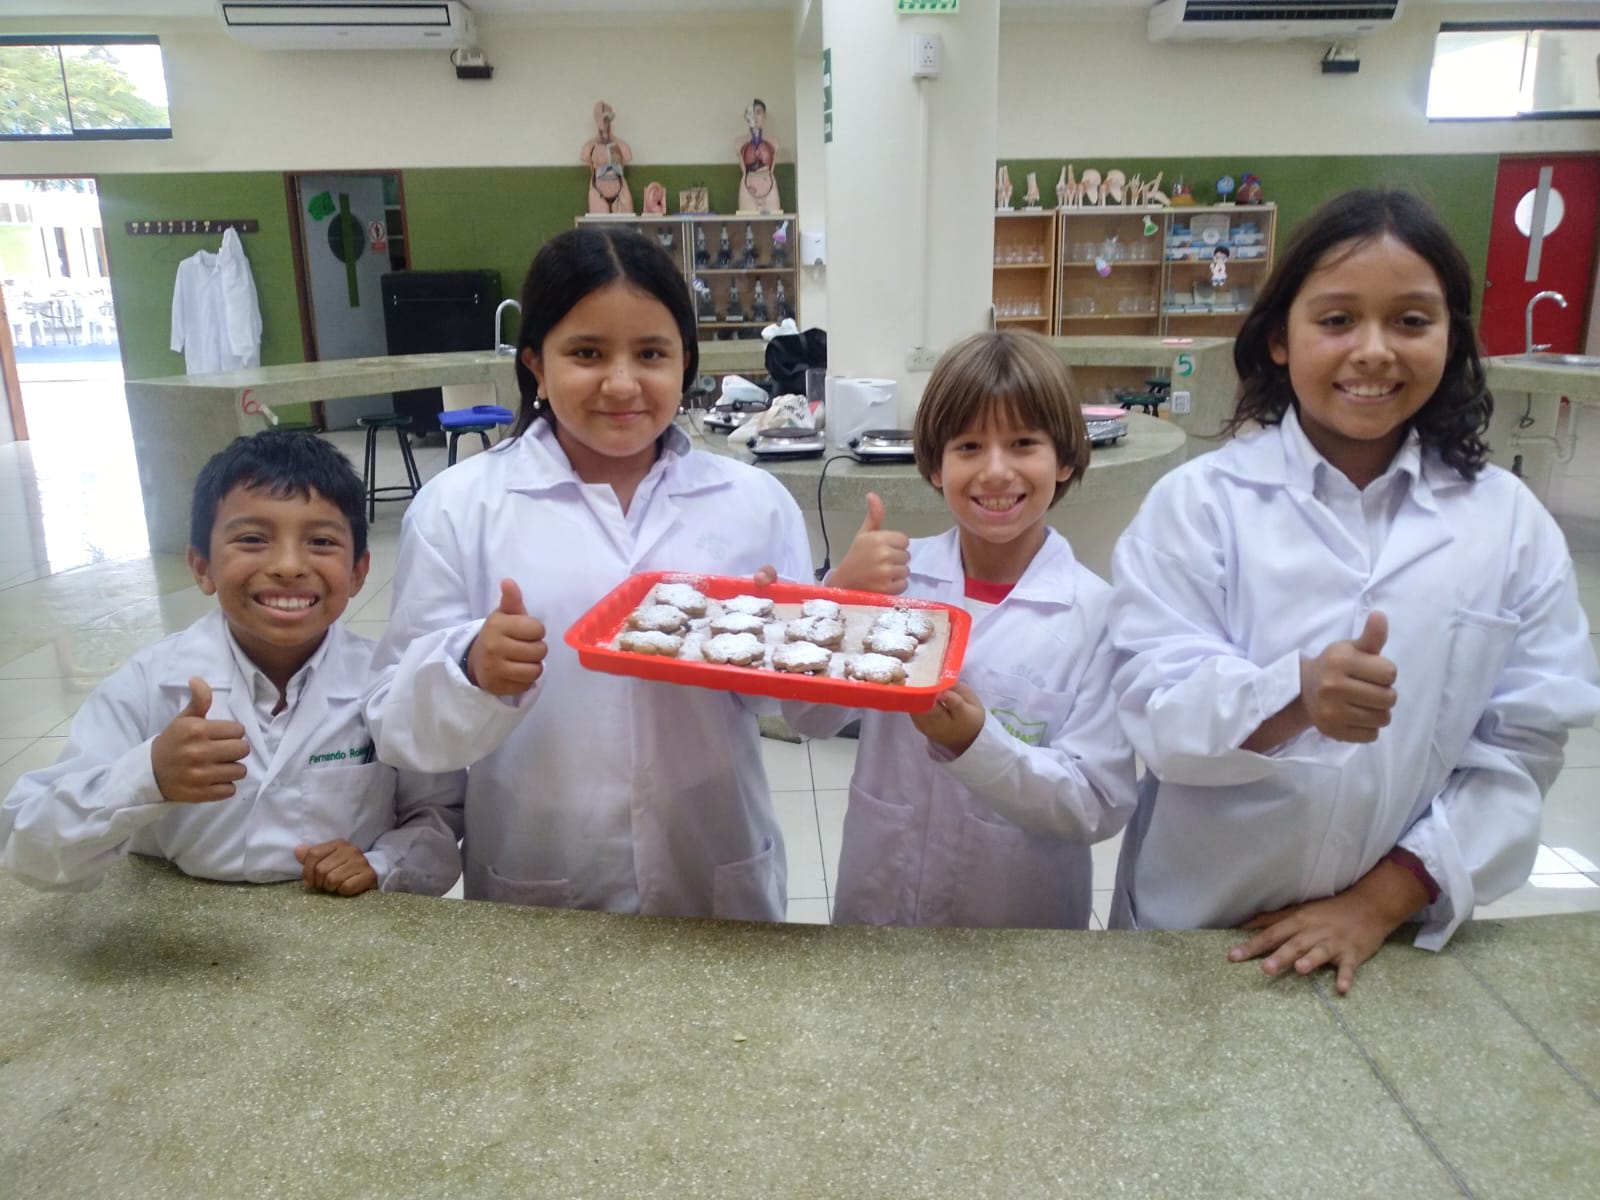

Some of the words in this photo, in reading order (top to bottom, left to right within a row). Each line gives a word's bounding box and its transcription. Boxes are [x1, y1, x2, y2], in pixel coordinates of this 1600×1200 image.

[1178, 353, 1192, 377] 5
[242, 389, 258, 416] 6
[308, 750, 346, 765] Fernando
